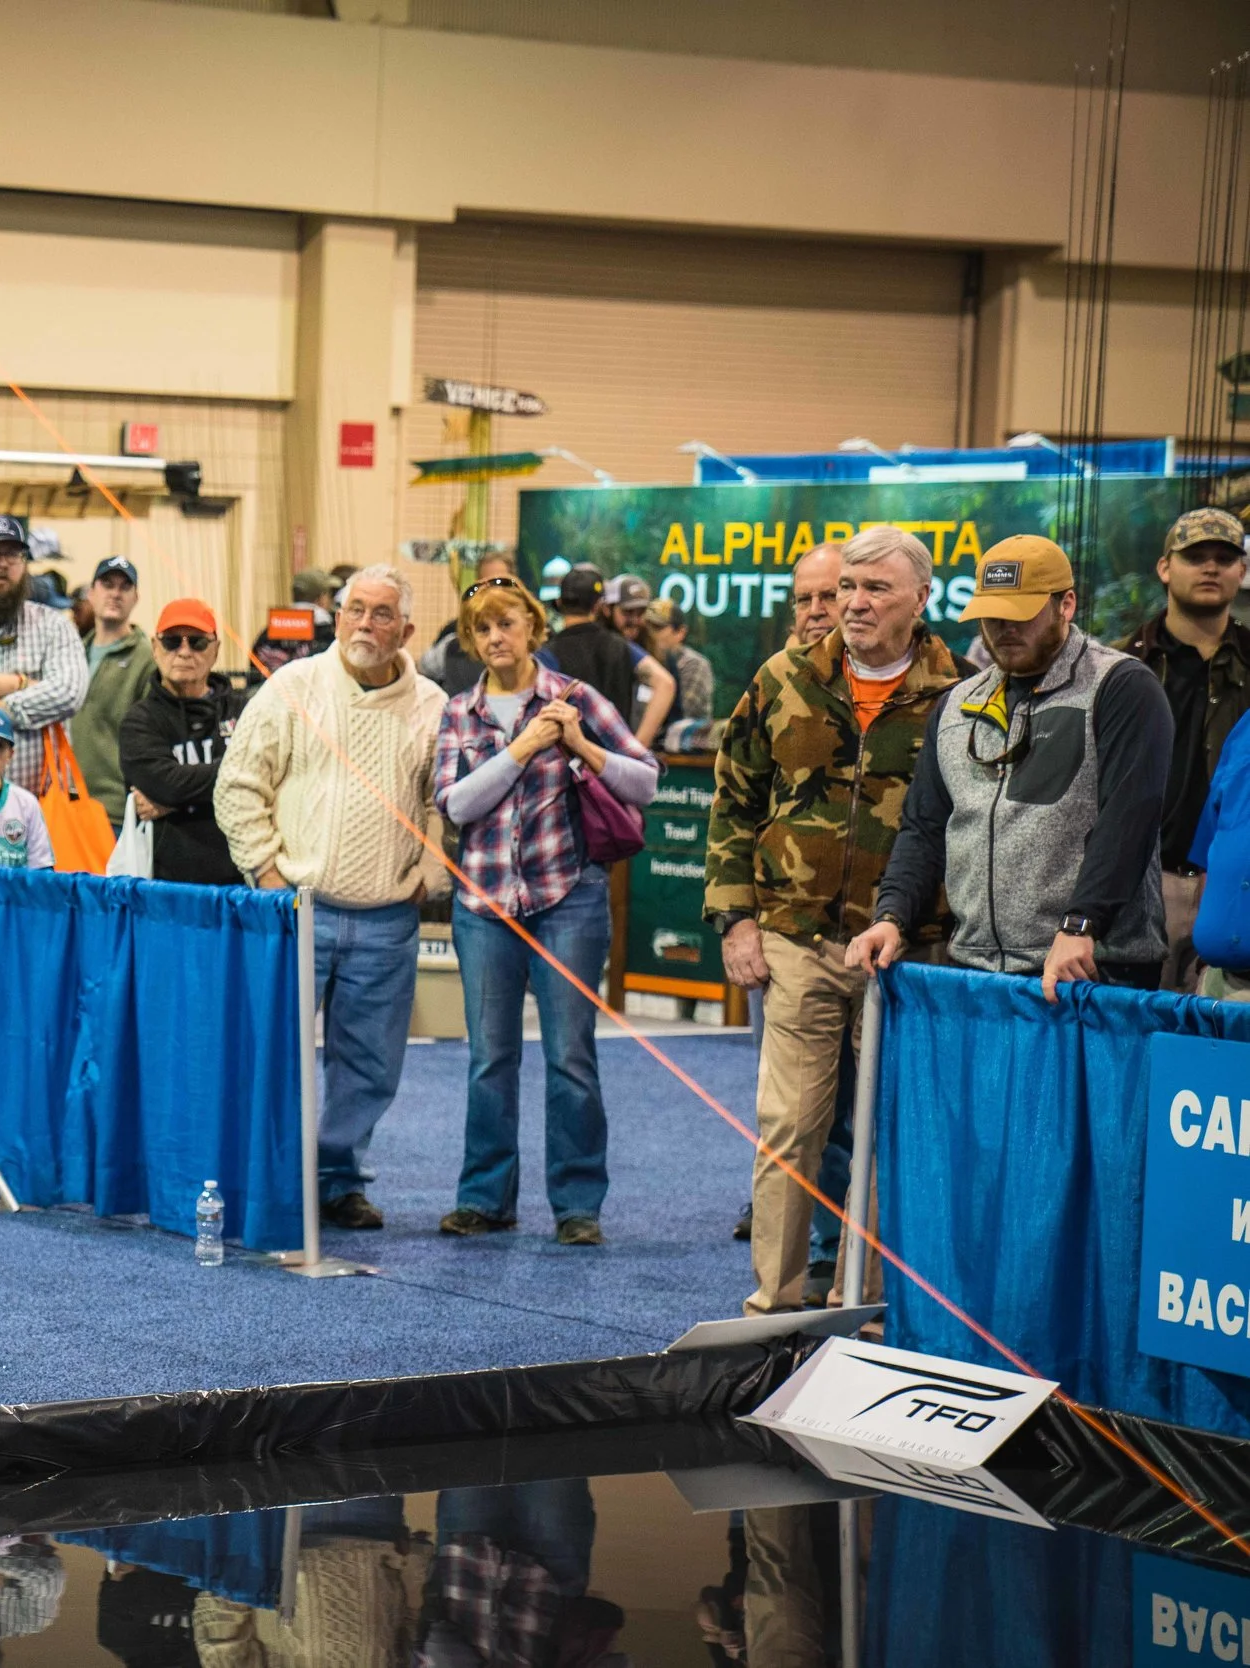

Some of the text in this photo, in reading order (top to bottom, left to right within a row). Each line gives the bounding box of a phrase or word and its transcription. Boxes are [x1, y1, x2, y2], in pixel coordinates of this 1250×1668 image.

[664, 822, 697, 841] Travel
[1158, 1270, 1250, 1339] BAC
[905, 1398, 997, 1433] TFO
[897, 1439, 967, 1460] WARRANTY
